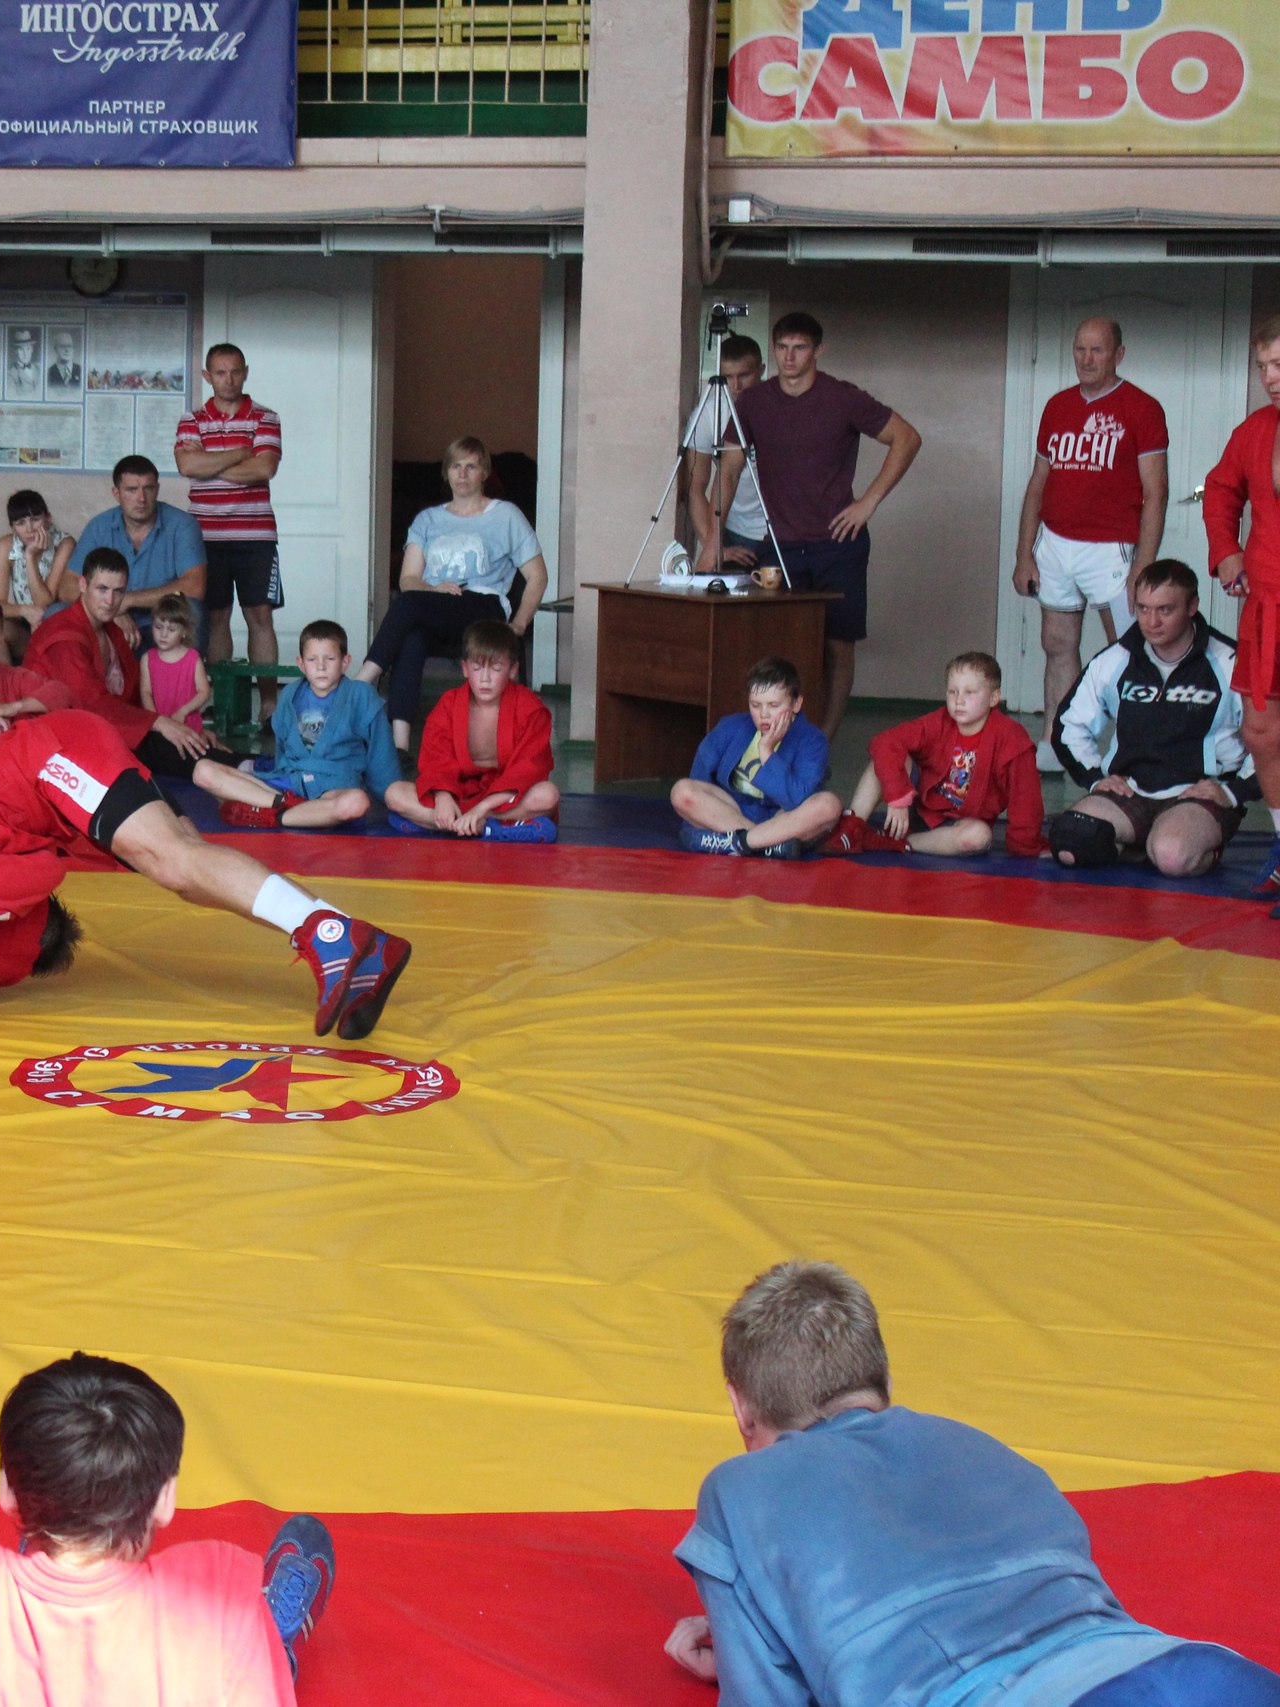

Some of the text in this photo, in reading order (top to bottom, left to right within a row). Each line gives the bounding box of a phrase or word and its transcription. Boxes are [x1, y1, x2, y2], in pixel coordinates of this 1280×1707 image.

[20, 3, 219, 33] ИНГОССТРАХ
[52, 32, 246, 74] Ingosstrakh
[728, 30, 1244, 122] САМБО
[89, 100, 166, 114] ПАРТНЕР
[140, 120, 259, 136] СТРАХОВЩИК
[1047, 432, 1118, 470] SOCHI
[267, 556, 278, 600] RUSSIA
